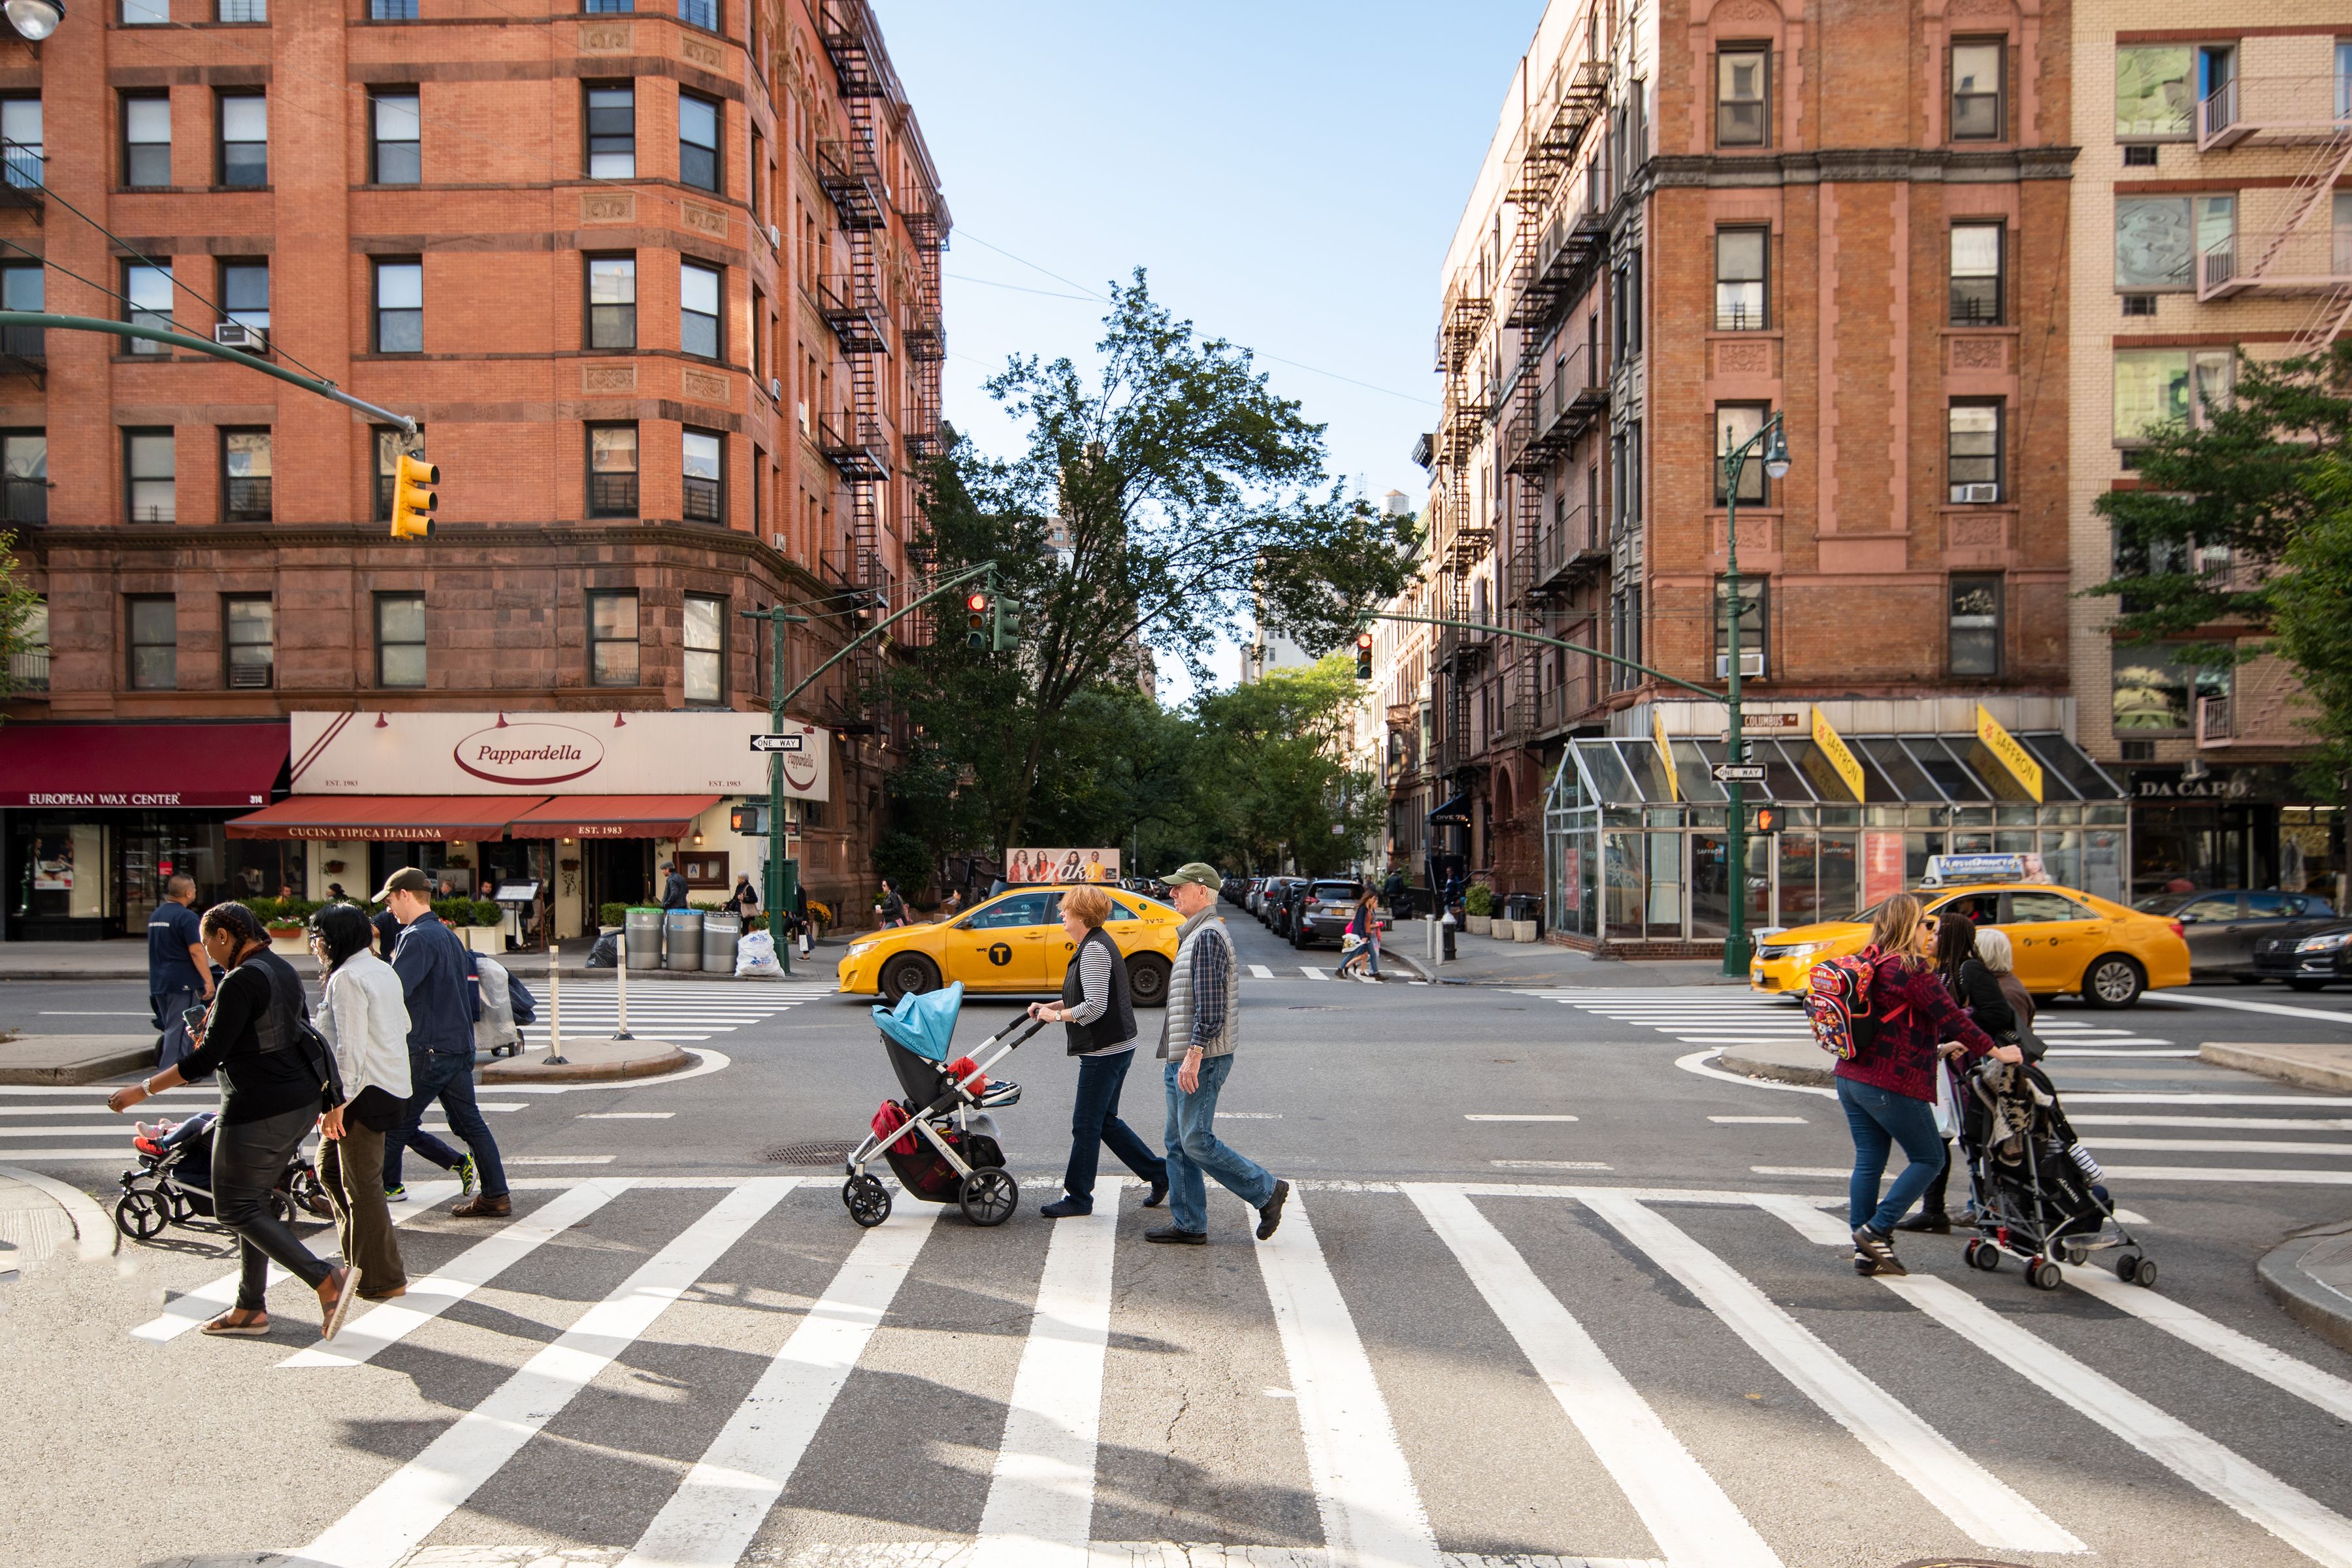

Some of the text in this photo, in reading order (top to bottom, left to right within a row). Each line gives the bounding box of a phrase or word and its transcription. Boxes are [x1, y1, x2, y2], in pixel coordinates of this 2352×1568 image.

[1744, 715, 1784, 727] COLUMBUS
[477, 745, 581, 764] Pappardella
[787, 752, 813, 769] Pappardella
[1827, 732, 1858, 782] SAFFRON
[1995, 731, 2036, 781] SAFFRON
[2139, 781, 2247, 797] DA CAPO
[29, 792, 180, 804] EUROPEAN WAX CENTER
[289, 827, 442, 838] CUCINA TIPICA ITALIANA
[1024, 849, 1096, 882] Saks
[994, 947, 1007, 963] T
